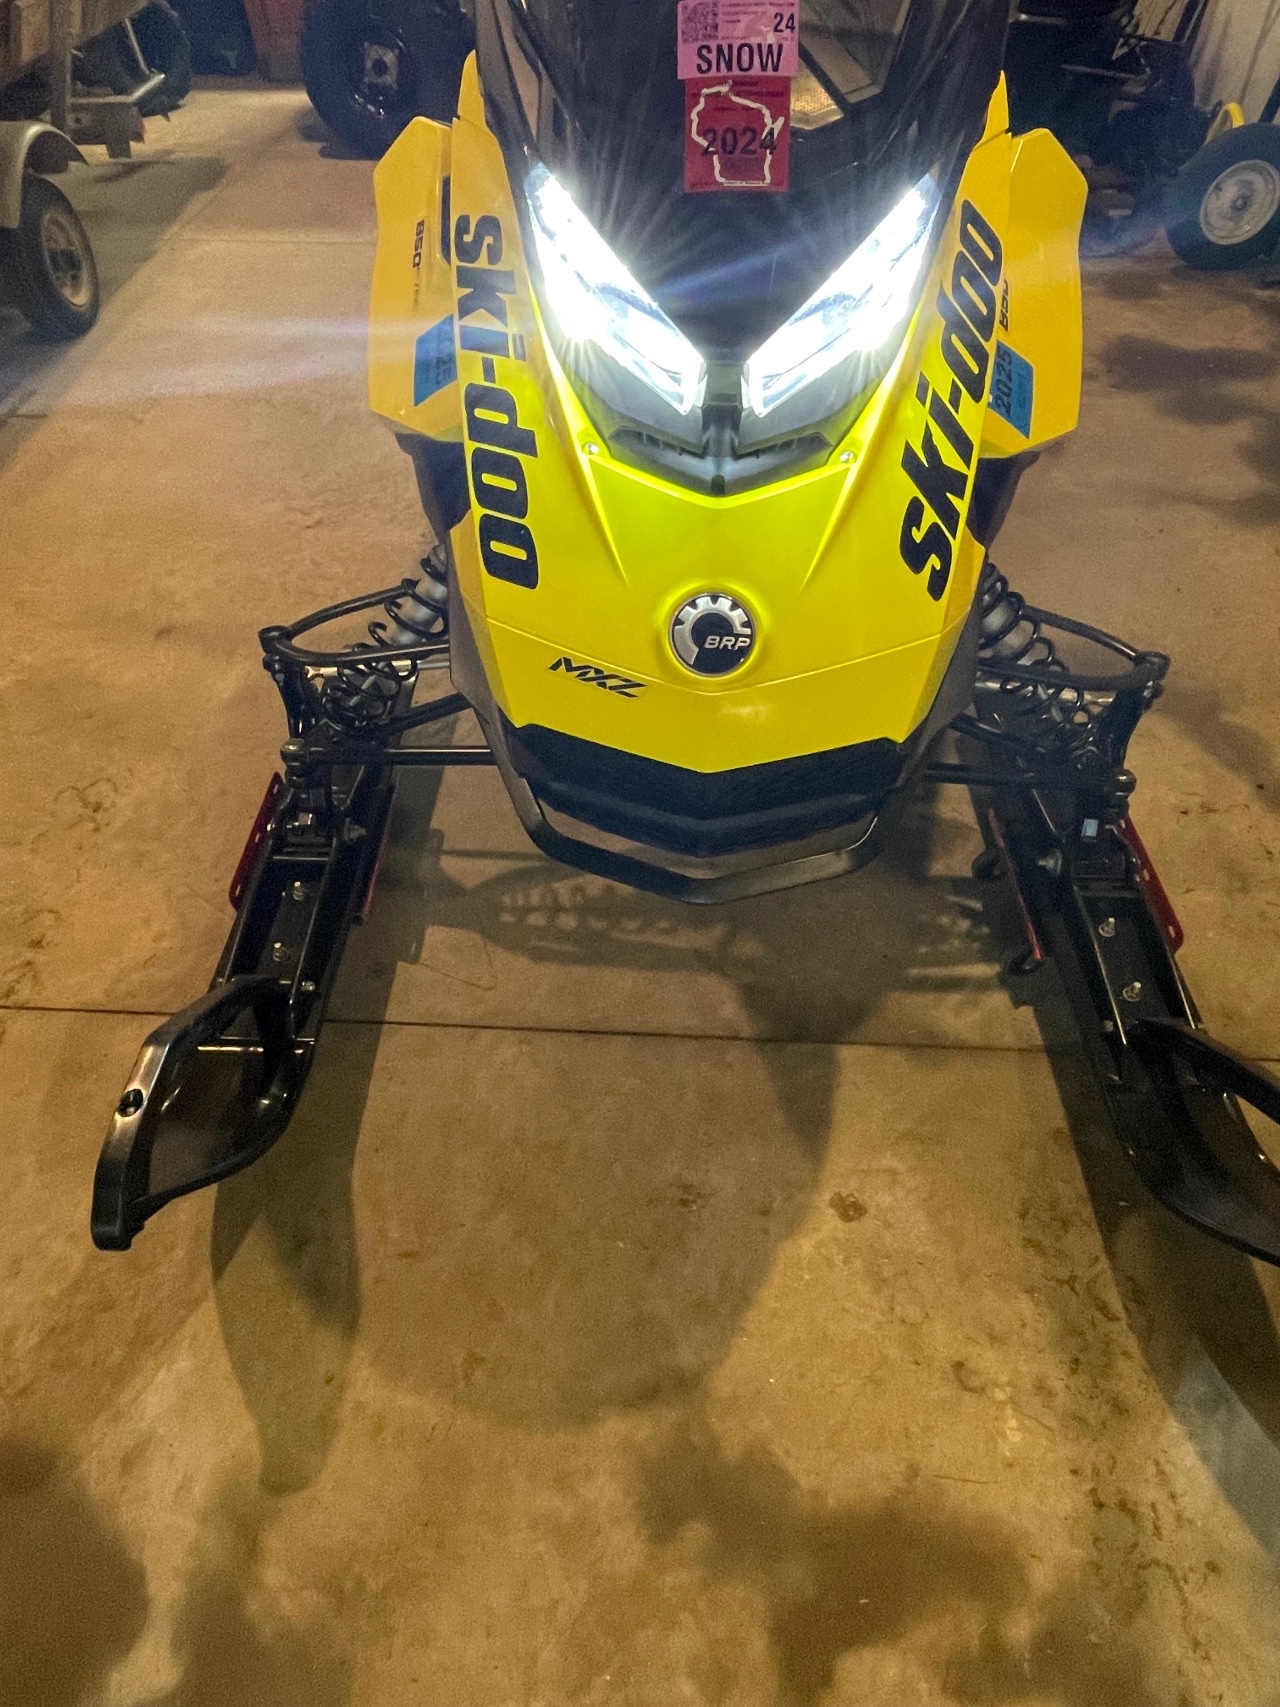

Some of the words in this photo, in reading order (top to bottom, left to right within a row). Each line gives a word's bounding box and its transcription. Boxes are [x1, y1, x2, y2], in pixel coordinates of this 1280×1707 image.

[773, 12, 795, 33] 24
[696, 43, 783, 74] SNOW
[702, 126, 777, 156] 2024
[994, 346, 1013, 418] 2025
[704, 635, 750, 650] BRP
[549, 656, 648, 698] MXZ
